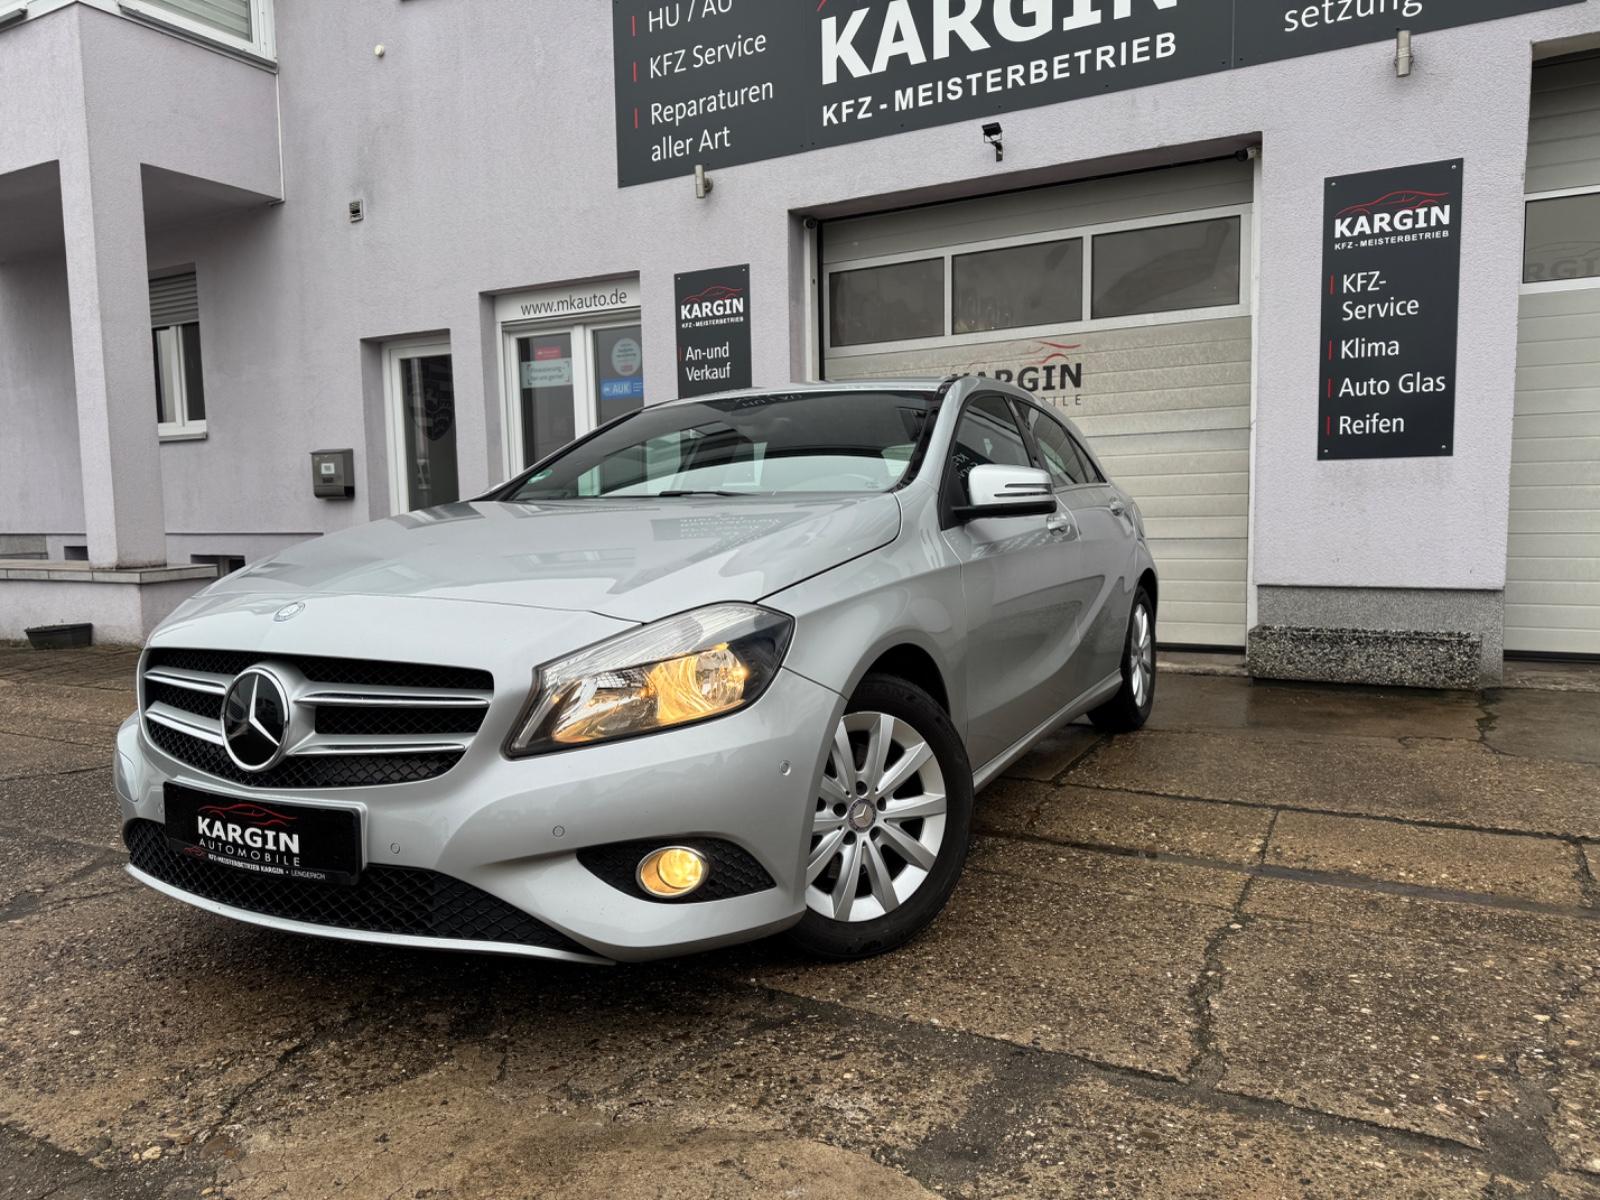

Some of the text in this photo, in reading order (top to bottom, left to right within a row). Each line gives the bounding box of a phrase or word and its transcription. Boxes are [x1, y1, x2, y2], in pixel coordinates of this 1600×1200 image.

[648, 3, 680, 33] HU
[701, 0, 733, 18] AU
[1284, 0, 1423, 32] setzung
[650, 34, 767, 79] KFZ Service
[821, 0, 1178, 85] KARG
[651, 81, 774, 126] Reparaturen
[651, 126, 731, 162] aller Art
[1334, 204, 1450, 239] KARGIN
[1342, 270, 1387, 294] KFZ-
[520, 288, 628, 317] www.mkauto.de
[680, 297, 744, 321] KARGIN
[1341, 297, 1420, 321] Service
[1340, 338, 1400, 360] Klima
[685, 361, 732, 382] Verkauf
[1338, 371, 1447, 399] Auto Glas
[1338, 412, 1405, 436] Reifen
[197, 816, 301, 854] KARGIN
[199, 838, 300, 867] AUTOMOBILE
[260, 865, 284, 875] KARGIN
